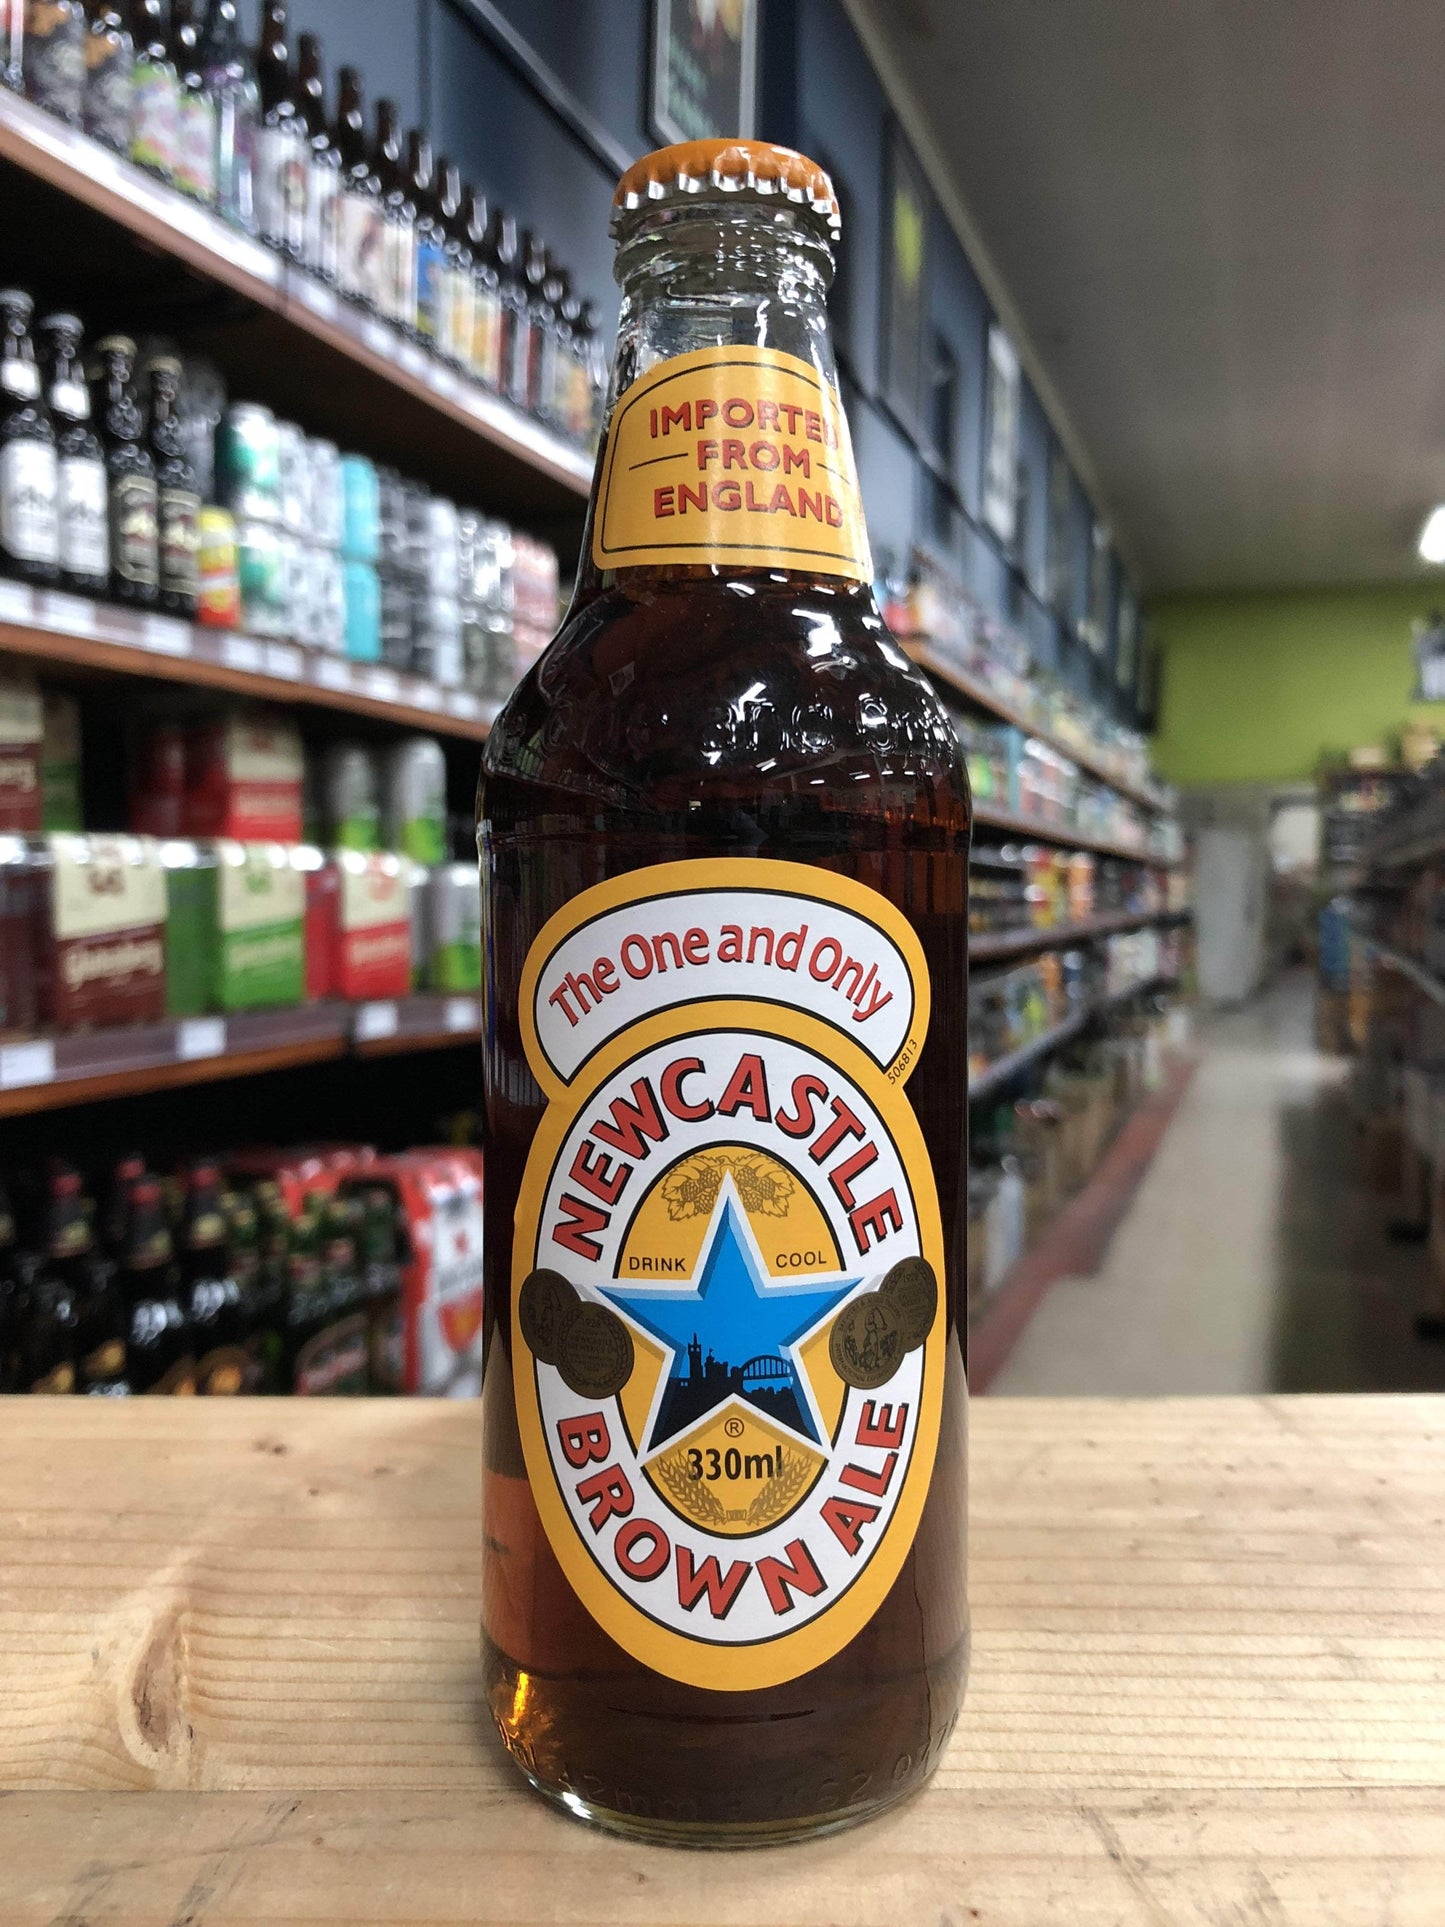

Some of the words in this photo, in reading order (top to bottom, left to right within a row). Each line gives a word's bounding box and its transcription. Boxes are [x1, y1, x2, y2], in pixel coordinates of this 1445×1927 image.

[650, 398, 839, 450] IMPORTED
[697, 438, 811, 479] FROM
[653, 480, 843, 528] ENGLAND
[549, 954, 620, 1027] The
[619, 924, 710, 979] One
[717, 924, 809, 971] and
[808, 935, 894, 1023] Only
[887, 1038, 919, 1086] 506813
[552, 1053, 904, 1262] NEWCASTLE
[628, 1256, 687, 1272] DRINK
[775, 1251, 827, 1269] COOL
[686, 1445, 783, 1481] 330ml
[556, 1411, 828, 1620] BROWN
[819, 1398, 910, 1557] ALE
